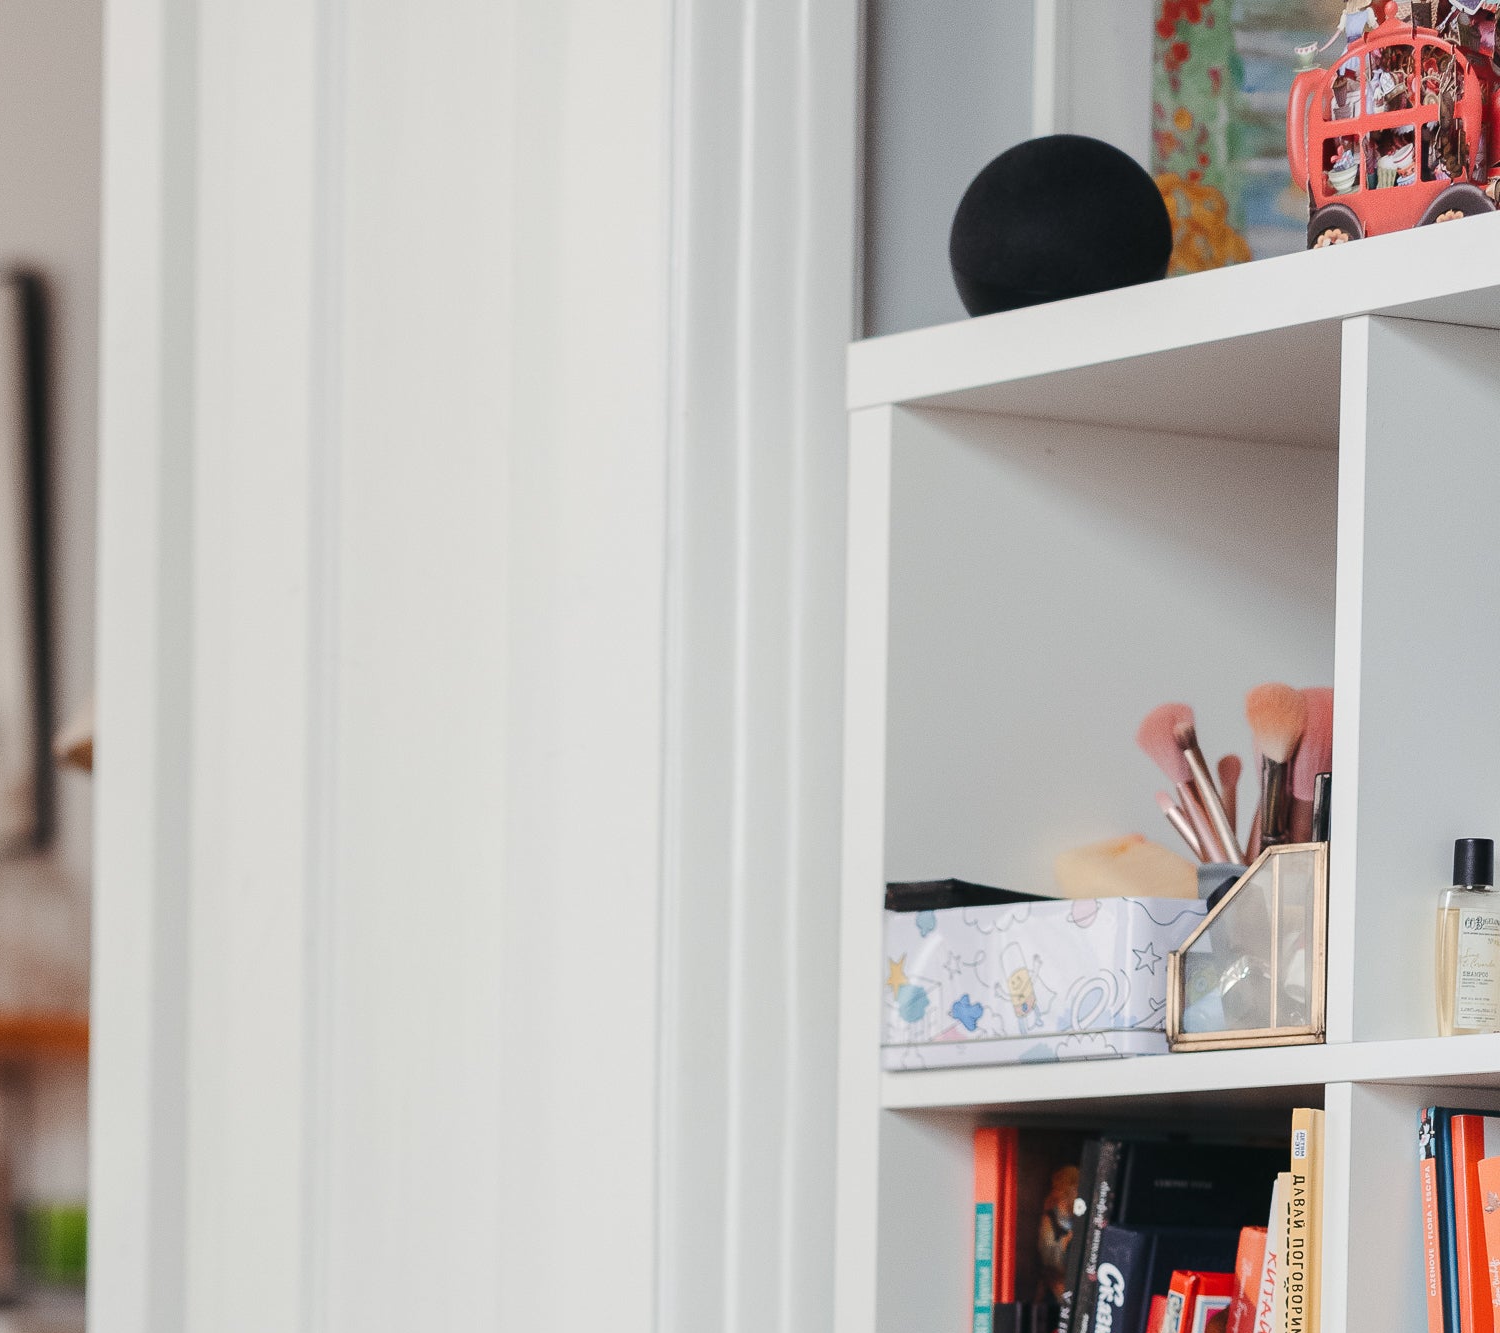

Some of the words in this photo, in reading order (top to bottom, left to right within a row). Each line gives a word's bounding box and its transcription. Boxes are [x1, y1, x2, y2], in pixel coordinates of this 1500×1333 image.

[1293, 1174, 1306, 1229] ДАВАЙ
[1425, 1165, 1433, 1202] ESCAPA
[1428, 1246, 1437, 1297] CAZENOVE
